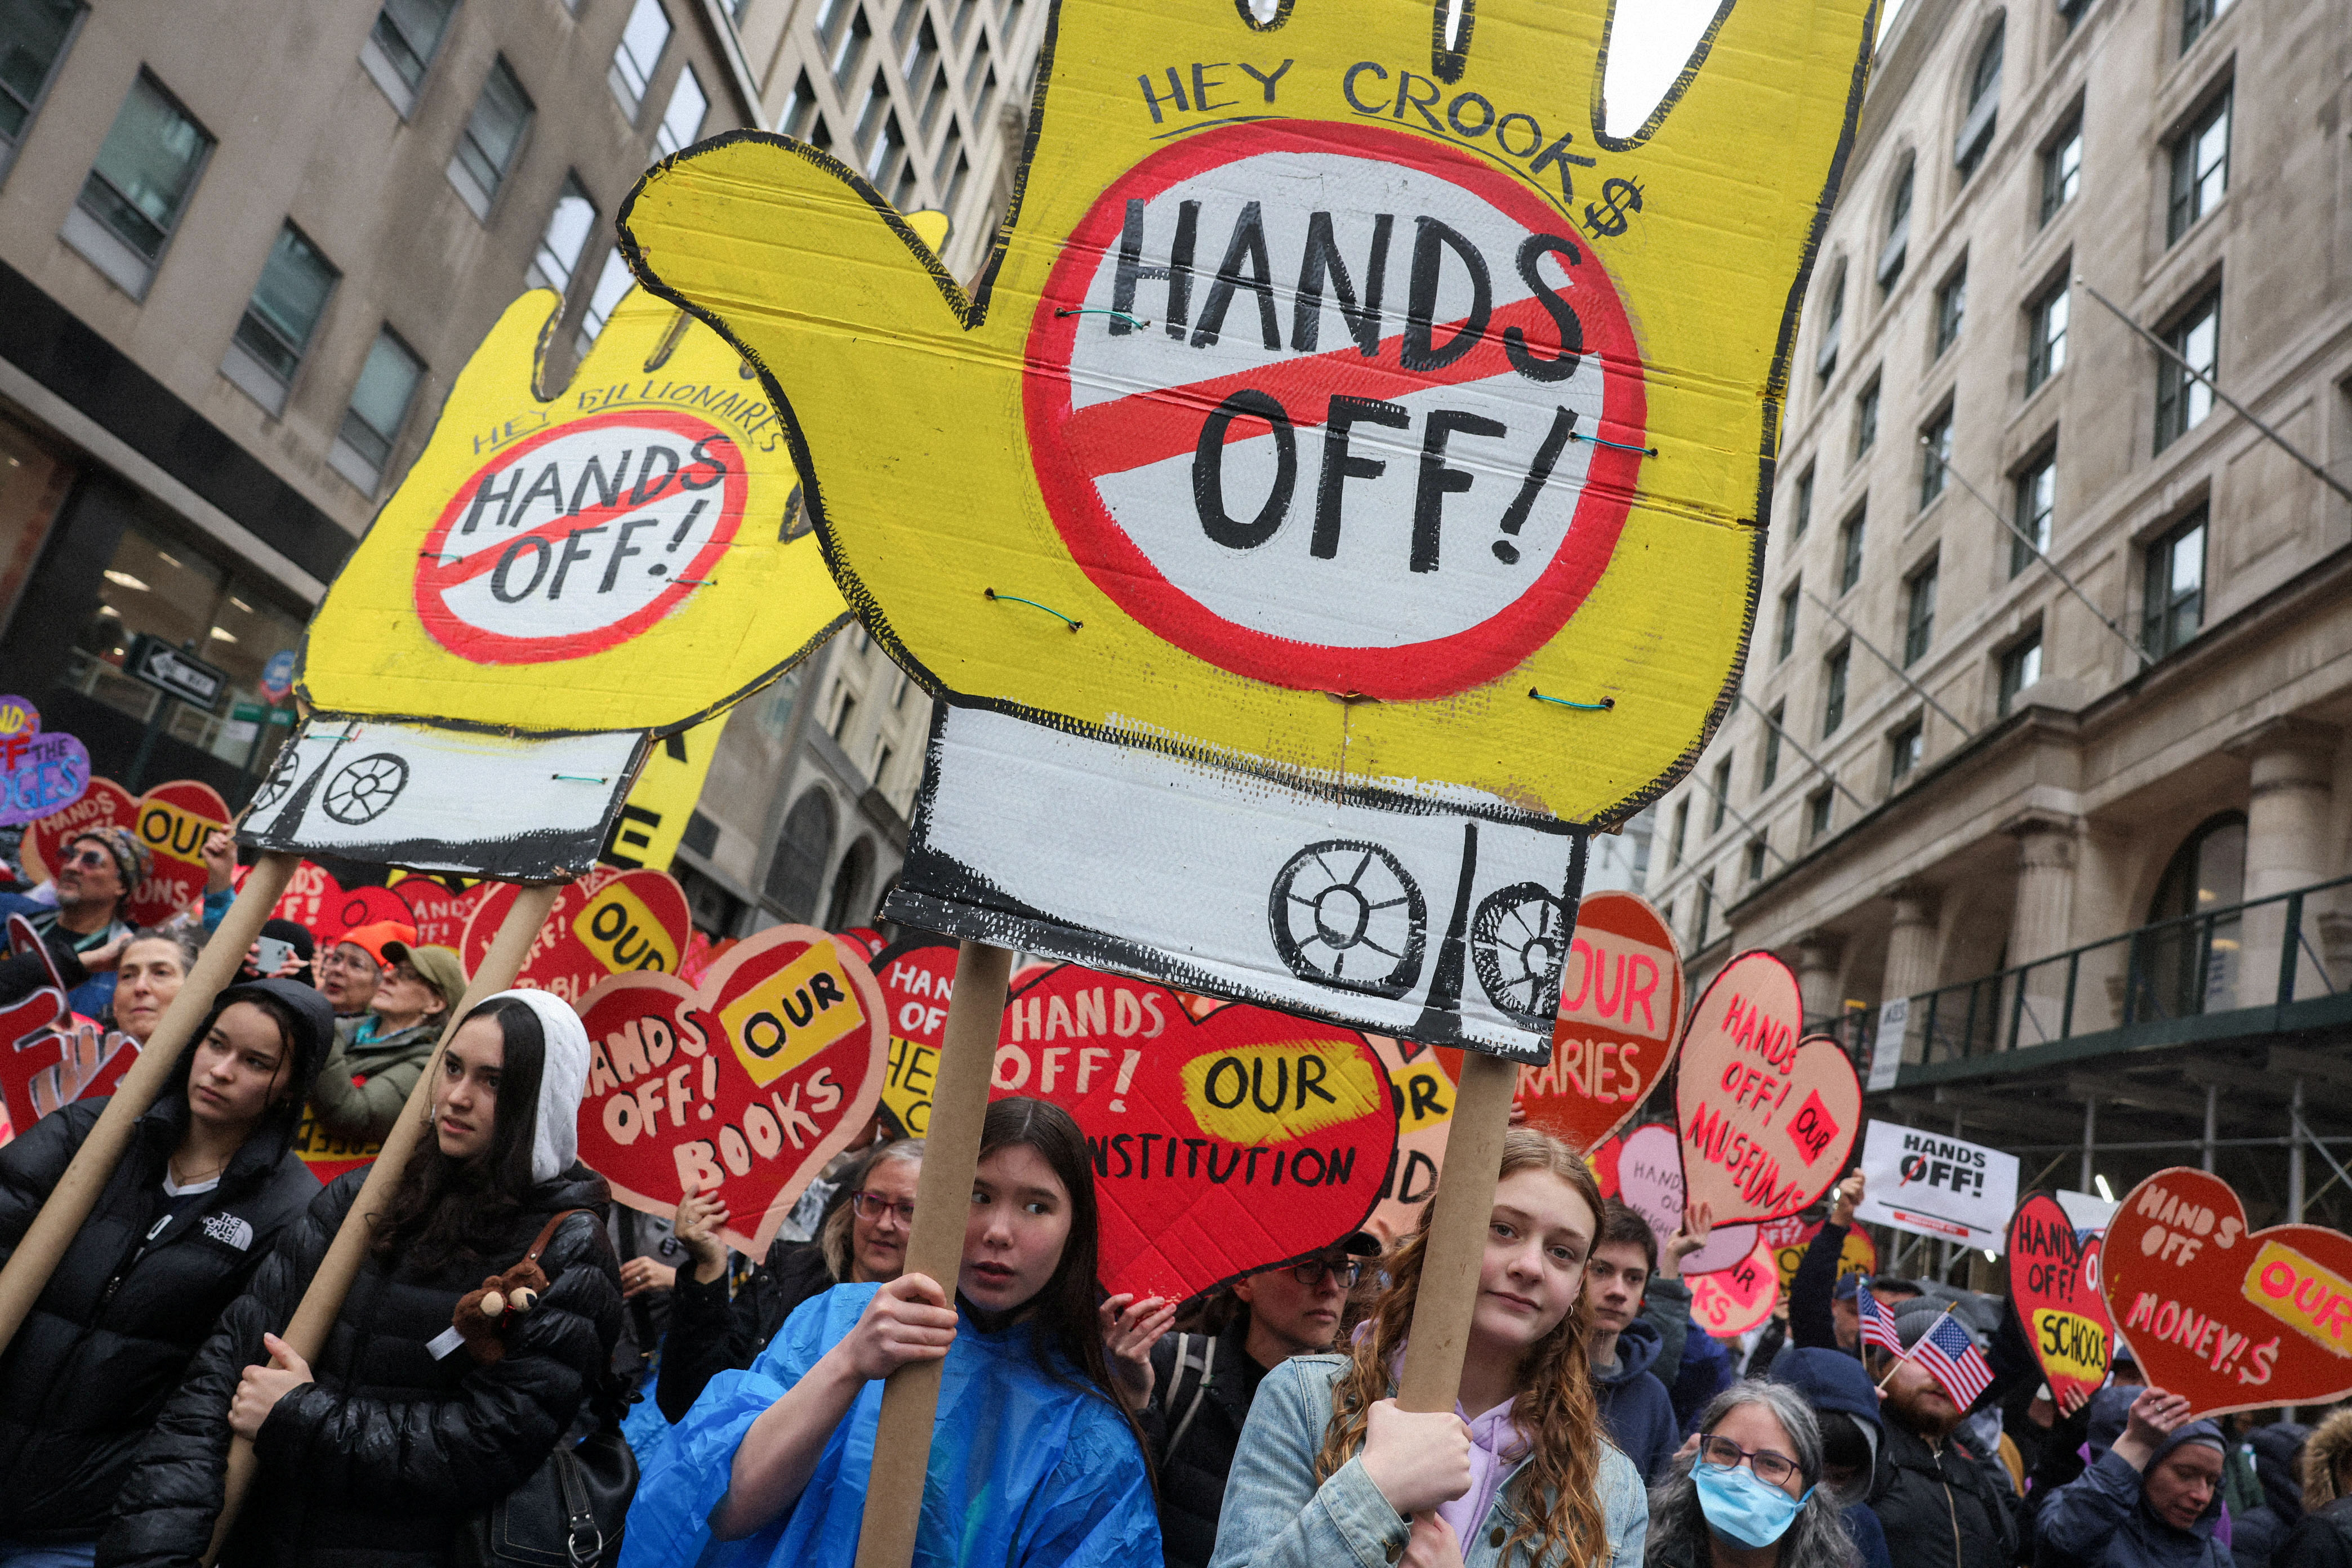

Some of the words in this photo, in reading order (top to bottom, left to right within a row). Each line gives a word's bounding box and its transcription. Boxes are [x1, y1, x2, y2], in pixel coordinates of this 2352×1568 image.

[1137, 58, 1294, 123] HEY
[1343, 61, 1646, 240] CROOK$
[1108, 197, 1583, 383] HANDS
[472, 408, 553, 455] HEY
[577, 380, 786, 453] BILLIONAIRES
[461, 434, 731, 535] HANDS
[1191, 388, 1579, 574] OFF!
[490, 498, 710, 604] OFF!
[413, 897, 476, 923] ANDS
[890, 961, 954, 1001] HAN
[741, 972, 845, 1059] OUR
[899, 1002, 947, 1035] OF
[1012, 986, 1166, 1043] HANDS
[1721, 992, 1798, 1075] HANDS
[583, 998, 709, 1098] ANDS
[603, 1054, 719, 1145] OFF!
[990, 1044, 1142, 1113] OFF!
[1204, 1054, 1337, 1114] OUR
[1721, 1061, 1792, 1126] OFF!
[673, 1066, 844, 1193] BOOKS
[1684, 1101, 1806, 1216] MUSEUMS
[1796, 1107, 1829, 1161] OUR
[1904, 1134, 1985, 1168] HANDS
[1087, 1133, 1356, 1187] NSTITUTION
[1634, 1162, 1683, 1195] HAND
[1900, 1154, 1984, 1198] OFF!
[201, 1215, 237, 1235] NORTH
[204, 1227, 234, 1244] FACE
[222, 1211, 242, 1228] THE
[2019, 1214, 2081, 1269] HANDS
[2137, 1183, 2246, 1250] HANDS
[2141, 1226, 2203, 1267] OFF
[2029, 1263, 2076, 1303] OFF!
[2260, 1260, 2352, 1339] OUR
[2043, 1314, 2108, 1374] SCHOOLS
